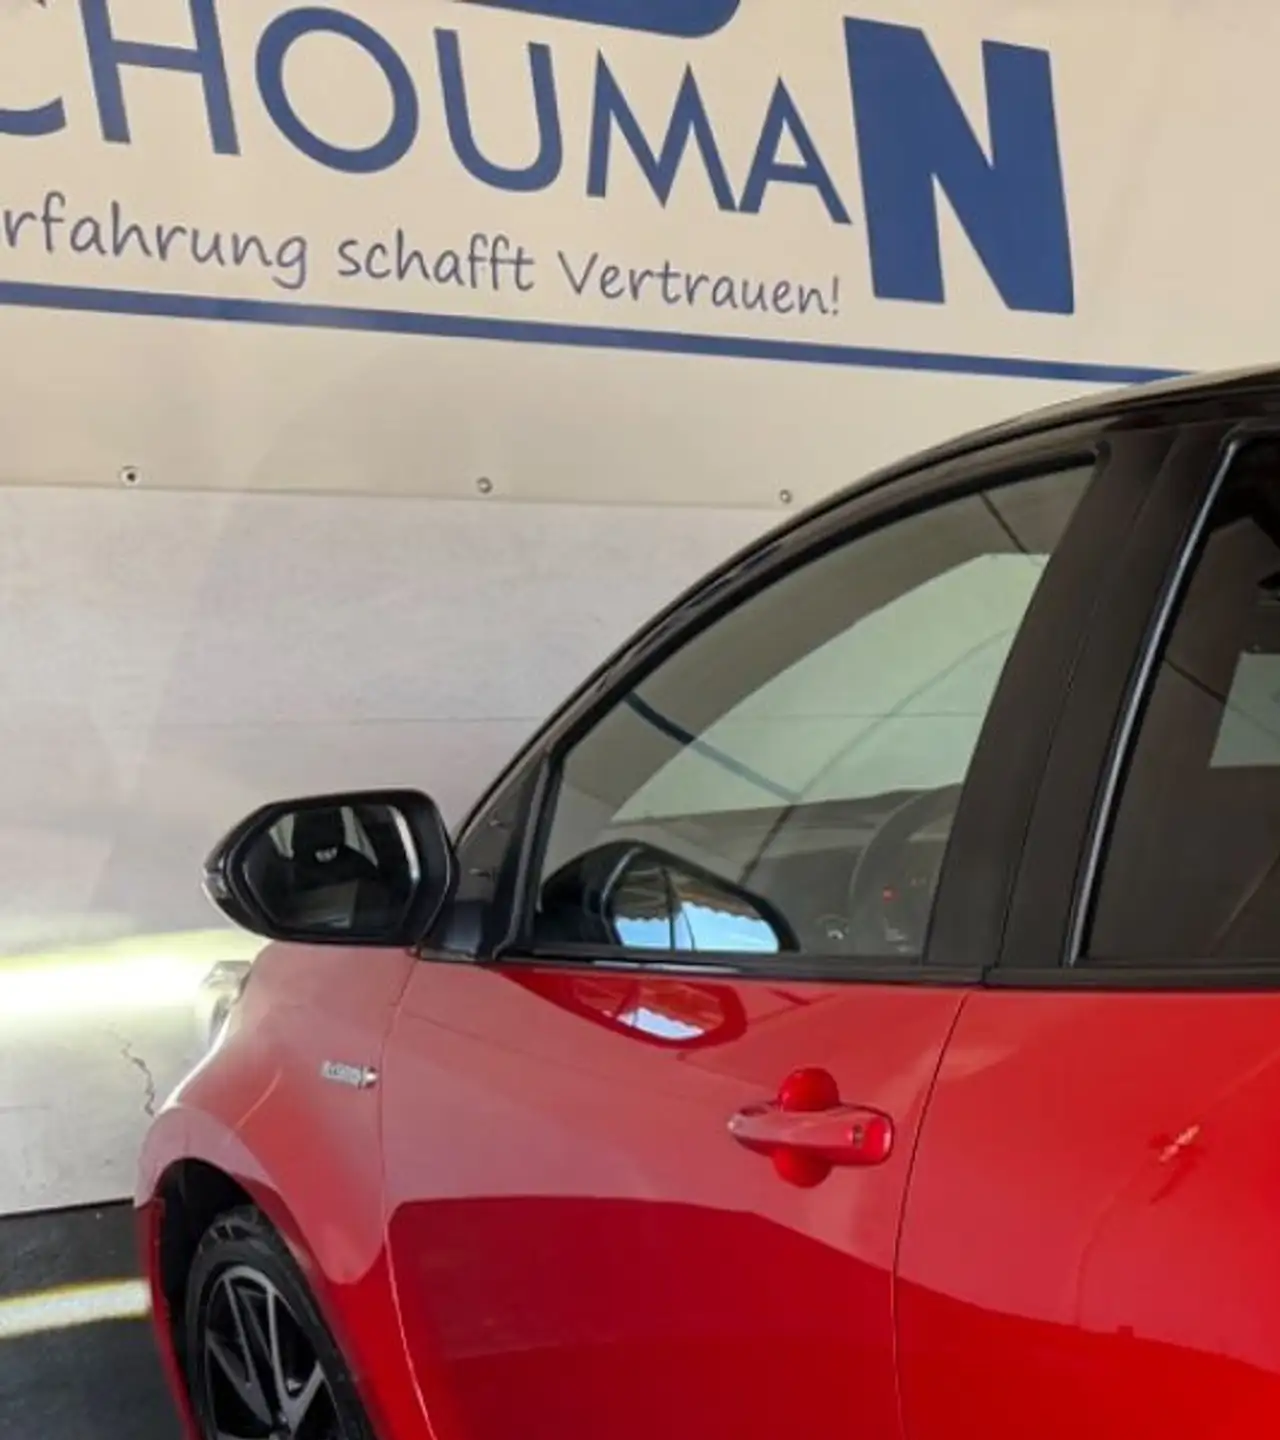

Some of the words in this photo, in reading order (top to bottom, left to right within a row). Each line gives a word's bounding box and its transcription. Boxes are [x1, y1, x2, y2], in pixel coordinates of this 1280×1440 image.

[0, 0, 1075, 315] HOUMAN
[337, 228, 536, 292] schafft
[556, 250, 841, 317] Vertrauen!
